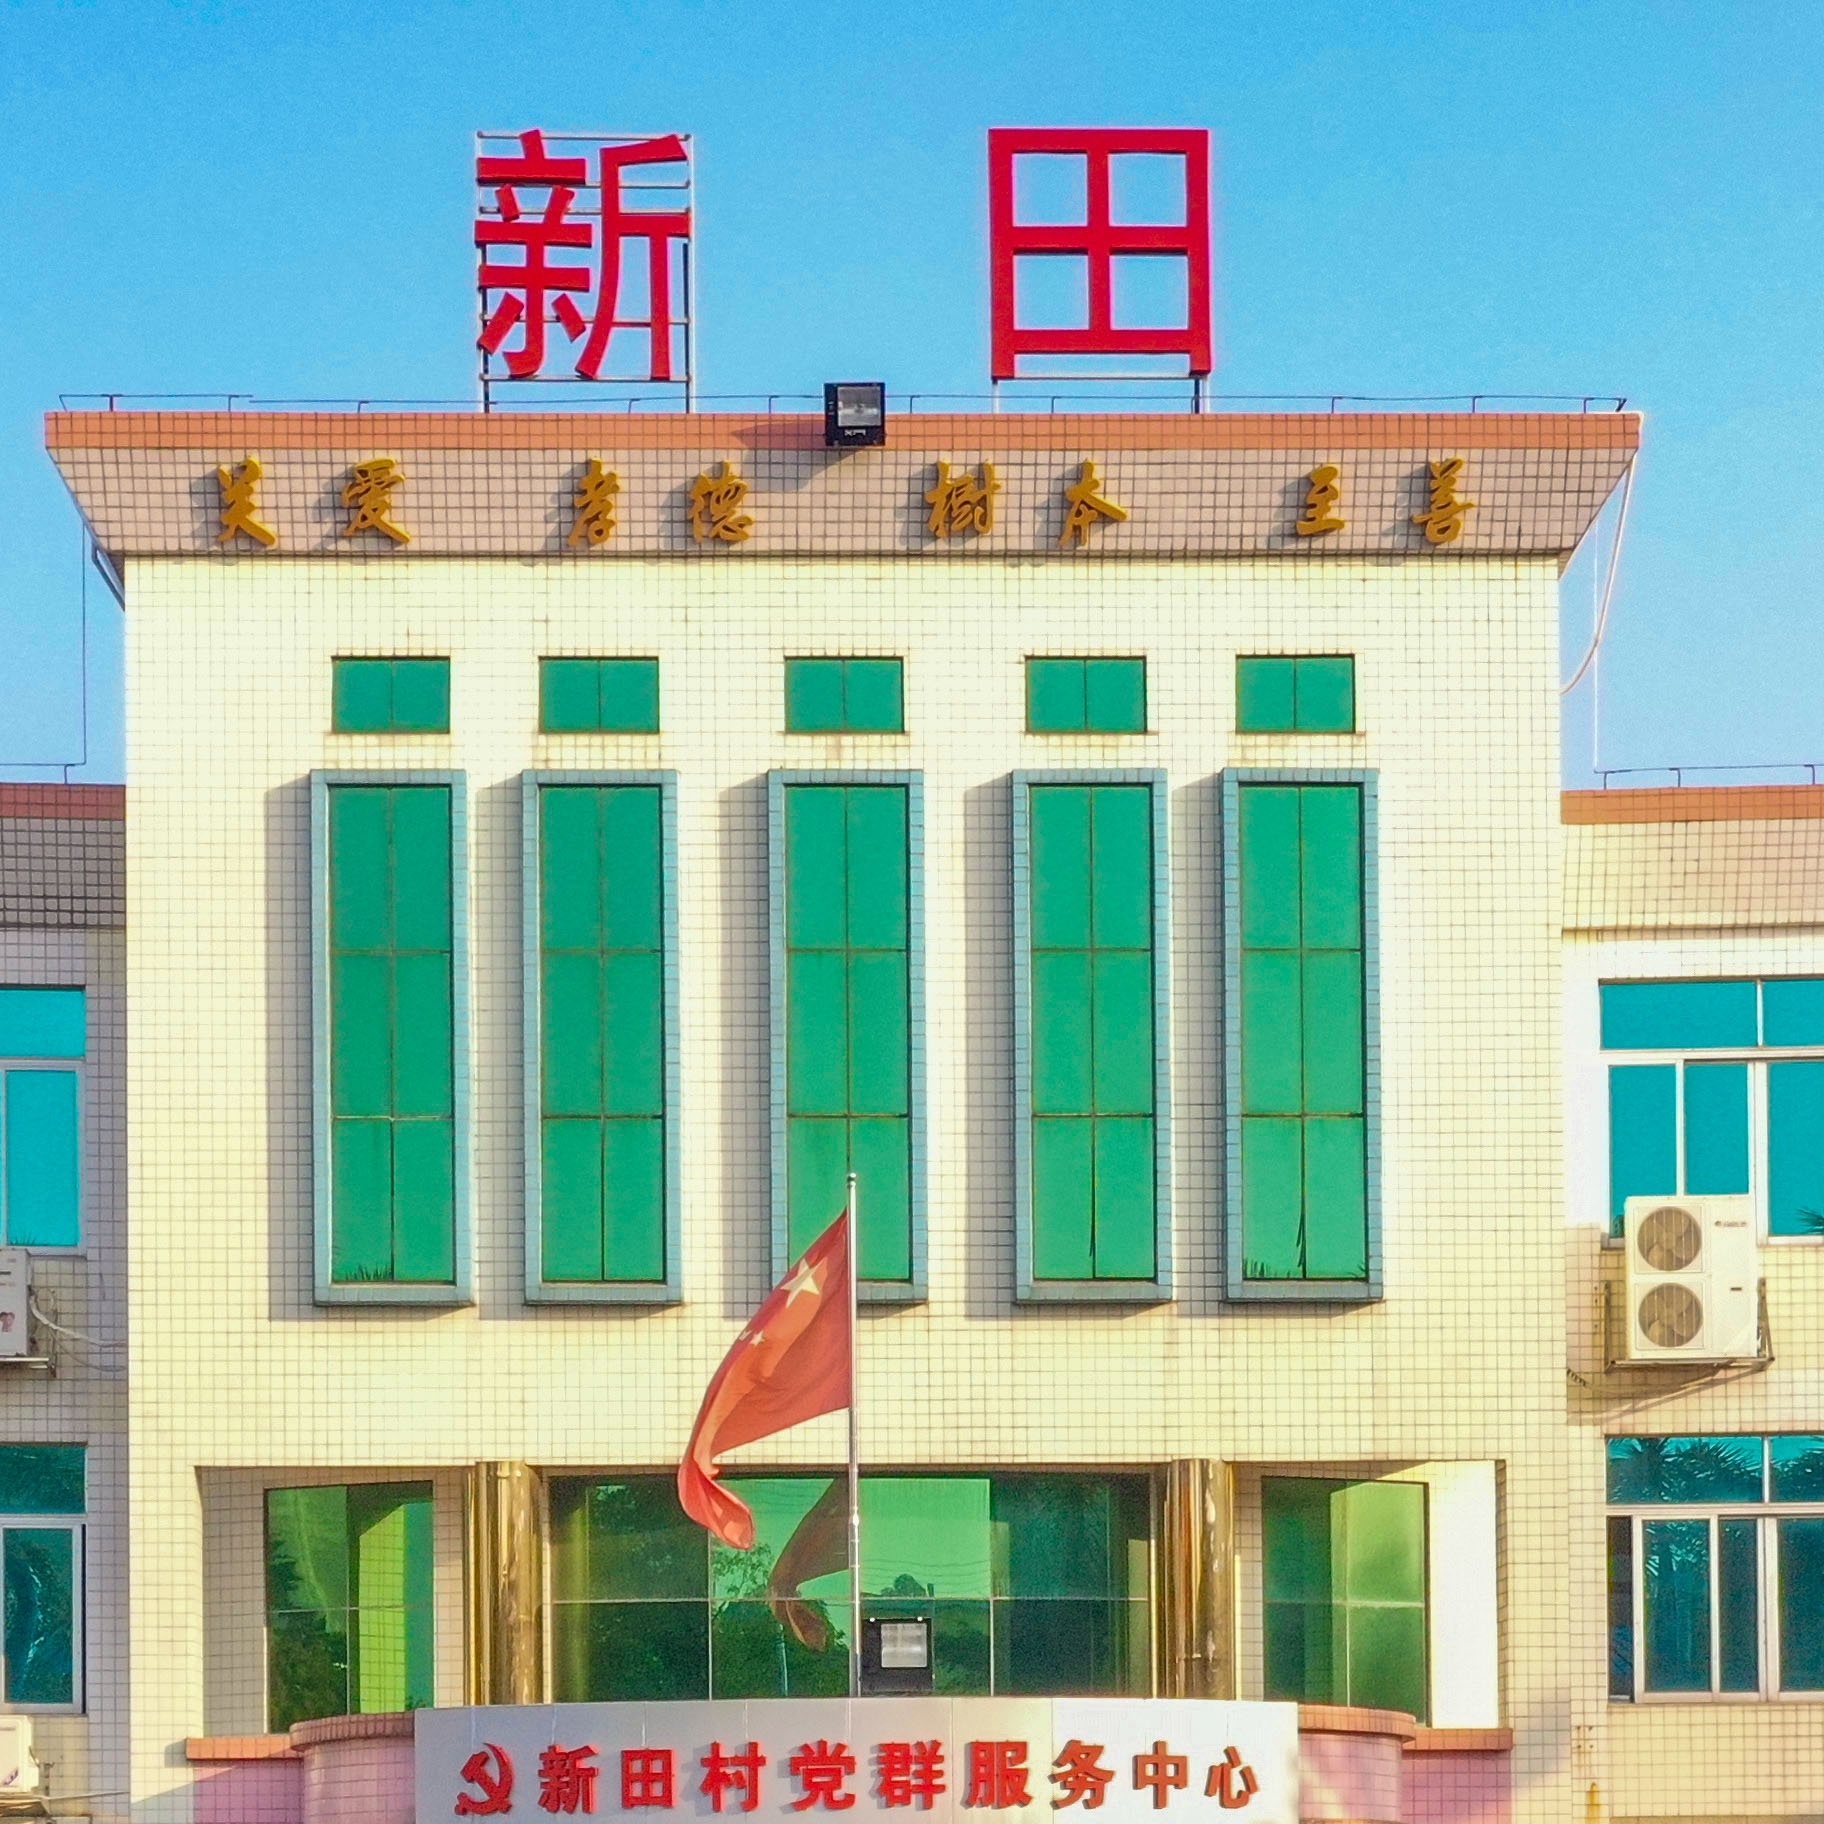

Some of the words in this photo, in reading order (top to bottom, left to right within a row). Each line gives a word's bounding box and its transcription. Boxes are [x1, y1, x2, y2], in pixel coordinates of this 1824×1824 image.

[473, 130, 1210, 382] 新田
[537, 1740, 1259, 1814] 新田村党群服务中心
